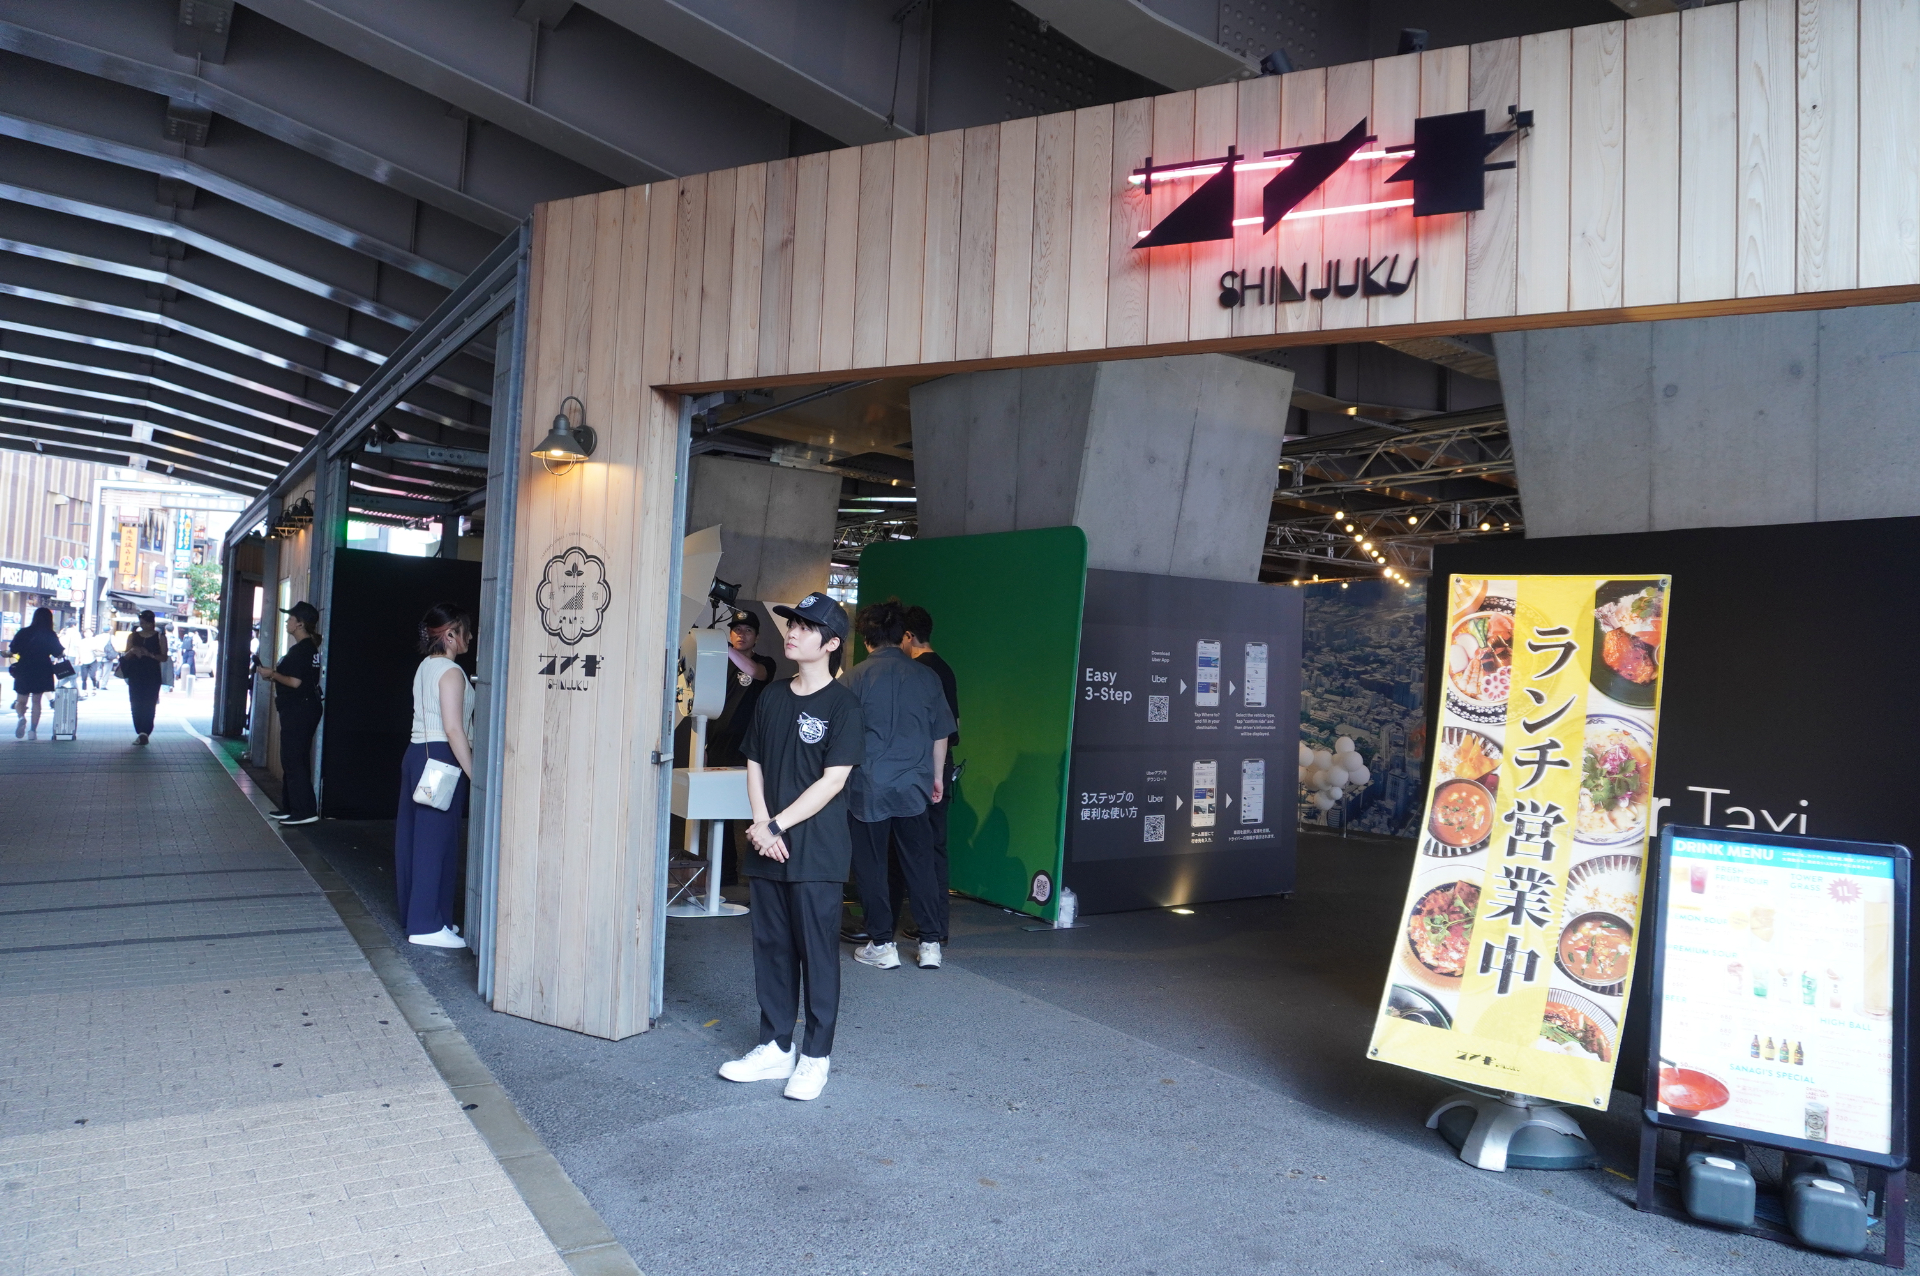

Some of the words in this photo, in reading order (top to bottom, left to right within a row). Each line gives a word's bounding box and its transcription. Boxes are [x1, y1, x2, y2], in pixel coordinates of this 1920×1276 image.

[1219, 254, 1419, 308] SHINJUKU
[1086, 668, 1117, 686] Easy
[1152, 674, 1168, 683] Uber
[548, 678, 589, 691] SHINJUKU
[1085, 686, 1132, 704] 3-Step
[1081, 792, 1134, 805] 3ステップの
[1148, 794, 1164, 803] Uber
[1080, 806, 1138, 821] 便利な使い方
[1477, 624, 1580, 996] ランチ営業中
[1675, 840, 1724, 856] DRINK
[1727, 846, 1774, 860] MENU
[1715, 865, 1744, 874] FRESH
[1715, 874, 1741, 883] FRUIT
[1744, 877, 1769, 886] SOUR
[1790, 873, 1824, 882] TOWER
[1790, 882, 1821, 892] GRASS
[1837, 886, 1852, 897] 1L
[1668, 944, 1709, 956] PREMIUM
[1712, 949, 1738, 959] SOUR
[1665, 994, 1687, 1003] BEER
[1820, 1017, 1846, 1027] HIGH
[1849, 1021, 1873, 1032] BALL
[1729, 1063, 1773, 1077] SANAGI'S
[1776, 1071, 1816, 1084] SPECIAL
